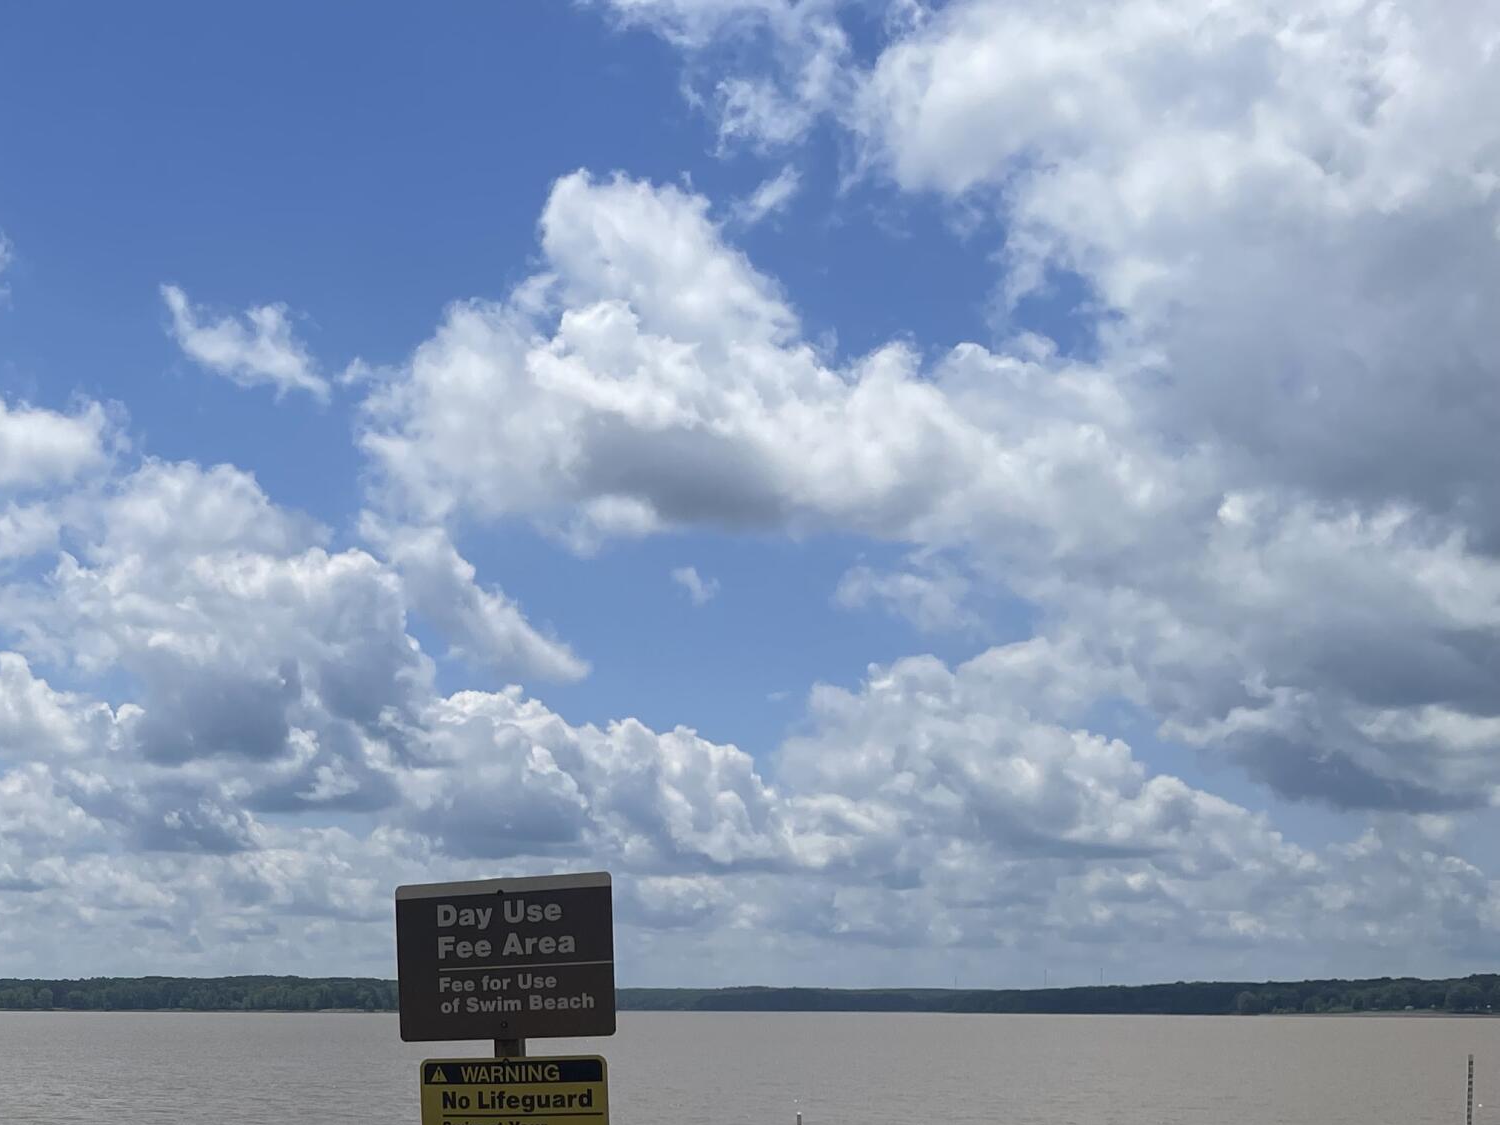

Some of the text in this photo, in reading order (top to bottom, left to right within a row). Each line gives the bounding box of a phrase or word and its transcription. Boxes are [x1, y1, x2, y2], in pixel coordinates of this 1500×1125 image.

[437, 900, 562, 929] Day Use
[437, 932, 575, 959] Fee Area
[439, 974, 557, 992] Fee for Use
[440, 992, 594, 1014] of Swim Beach
[461, 1064, 560, 1082] WARNING
[443, 1089, 592, 1112] No Lifeguard
